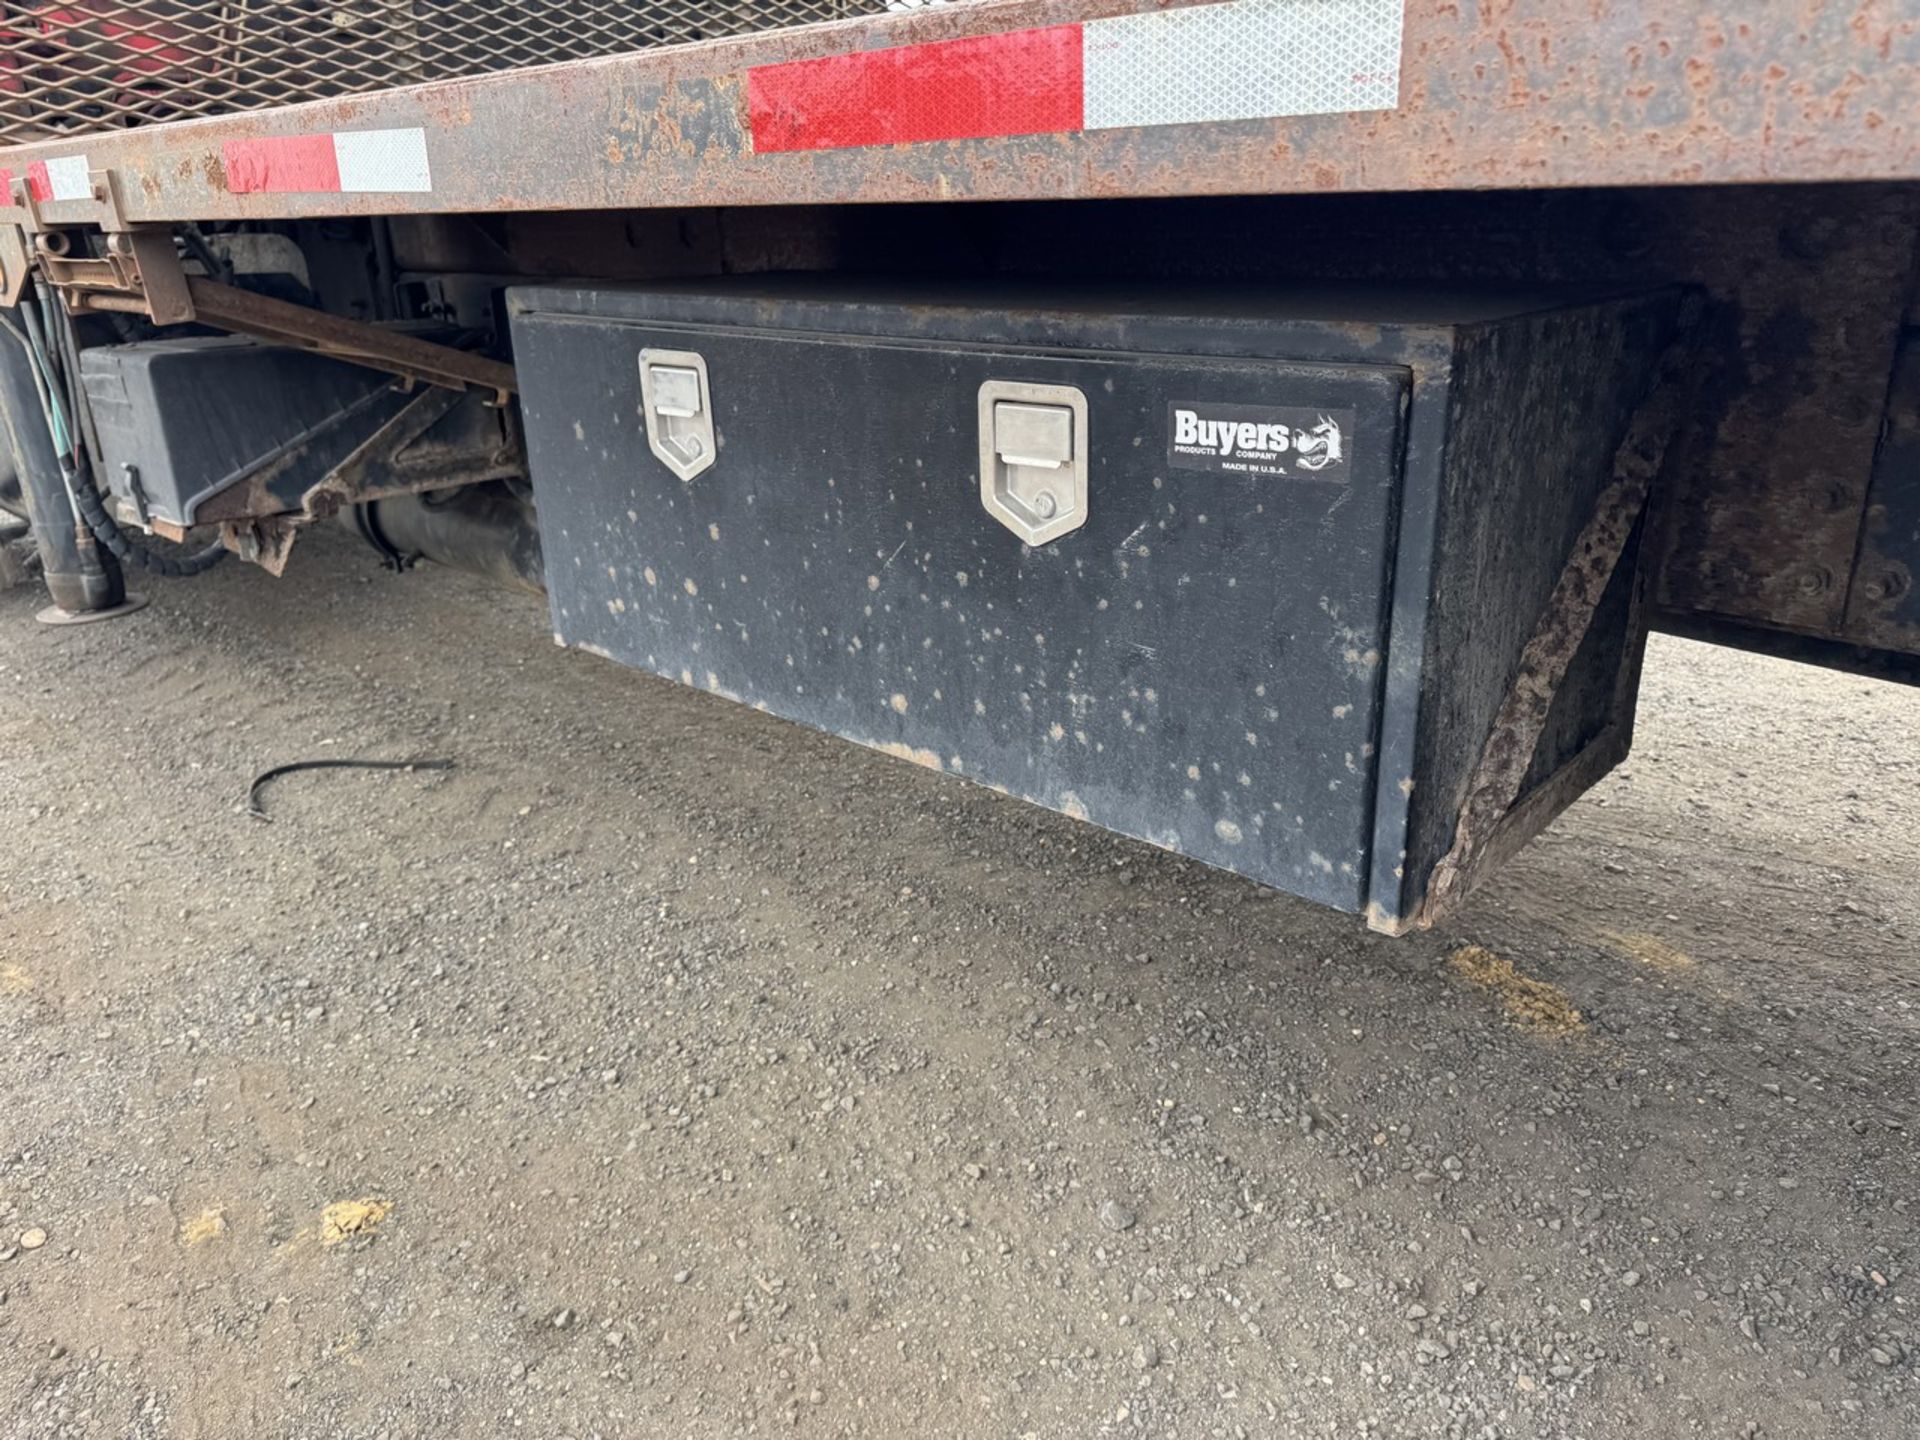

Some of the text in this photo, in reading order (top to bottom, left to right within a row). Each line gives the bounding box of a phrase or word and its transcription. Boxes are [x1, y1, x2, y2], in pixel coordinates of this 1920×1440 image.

[1174, 410, 1290, 456] Buyers
[1174, 445, 1277, 460] PRODUCTS COMPANY
[1222, 462, 1287, 474] MADE IN U.S.A.
